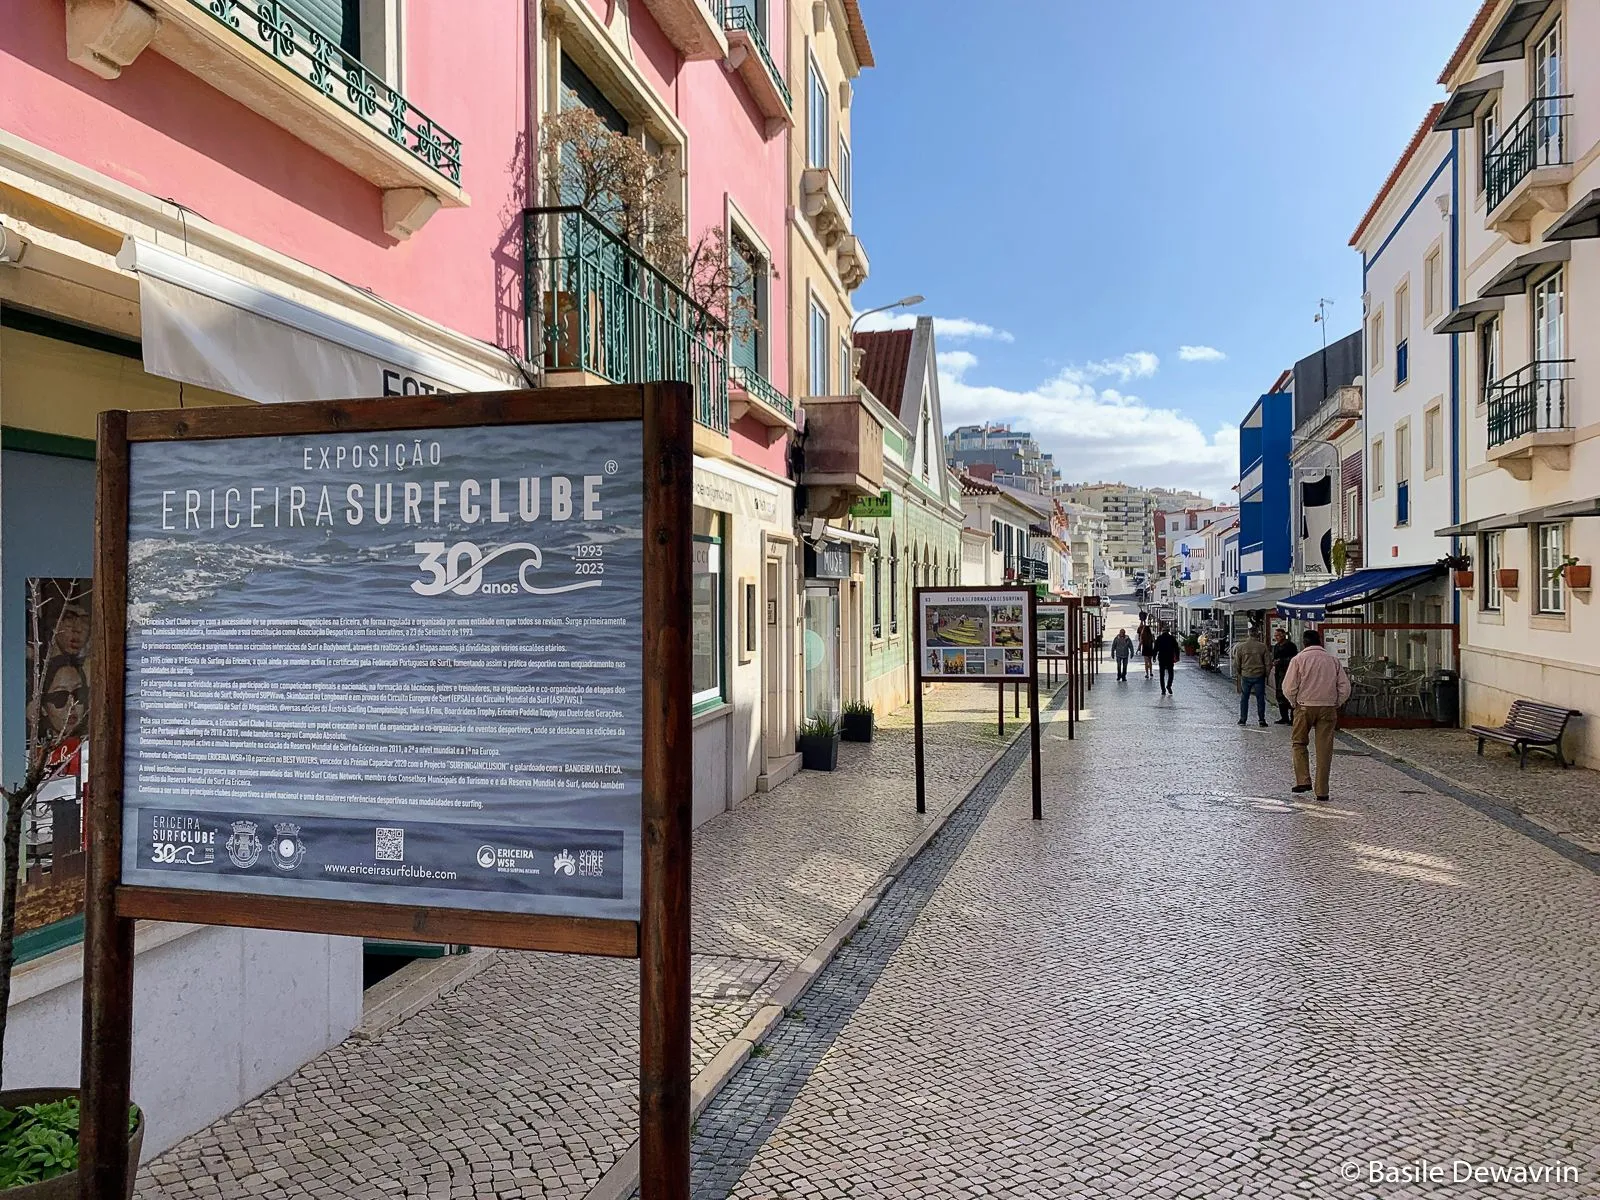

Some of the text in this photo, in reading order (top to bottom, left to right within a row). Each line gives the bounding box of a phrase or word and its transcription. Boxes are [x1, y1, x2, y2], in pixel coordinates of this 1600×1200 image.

[303, 440, 441, 471] EXPOSIÇÃO
[576, 544, 603, 557] 1993
[410, 542, 483, 596] 30
[575, 562, 604, 575] 2023
[482, 582, 518, 594] anos
[154, 816, 200, 830] ERICEIRA
[152, 842, 176, 863] 30
[498, 848, 534, 859] ERICEIRA
[498, 859, 515, 868] WSR
[324, 862, 457, 880] www.ericeirasurfclube.com
